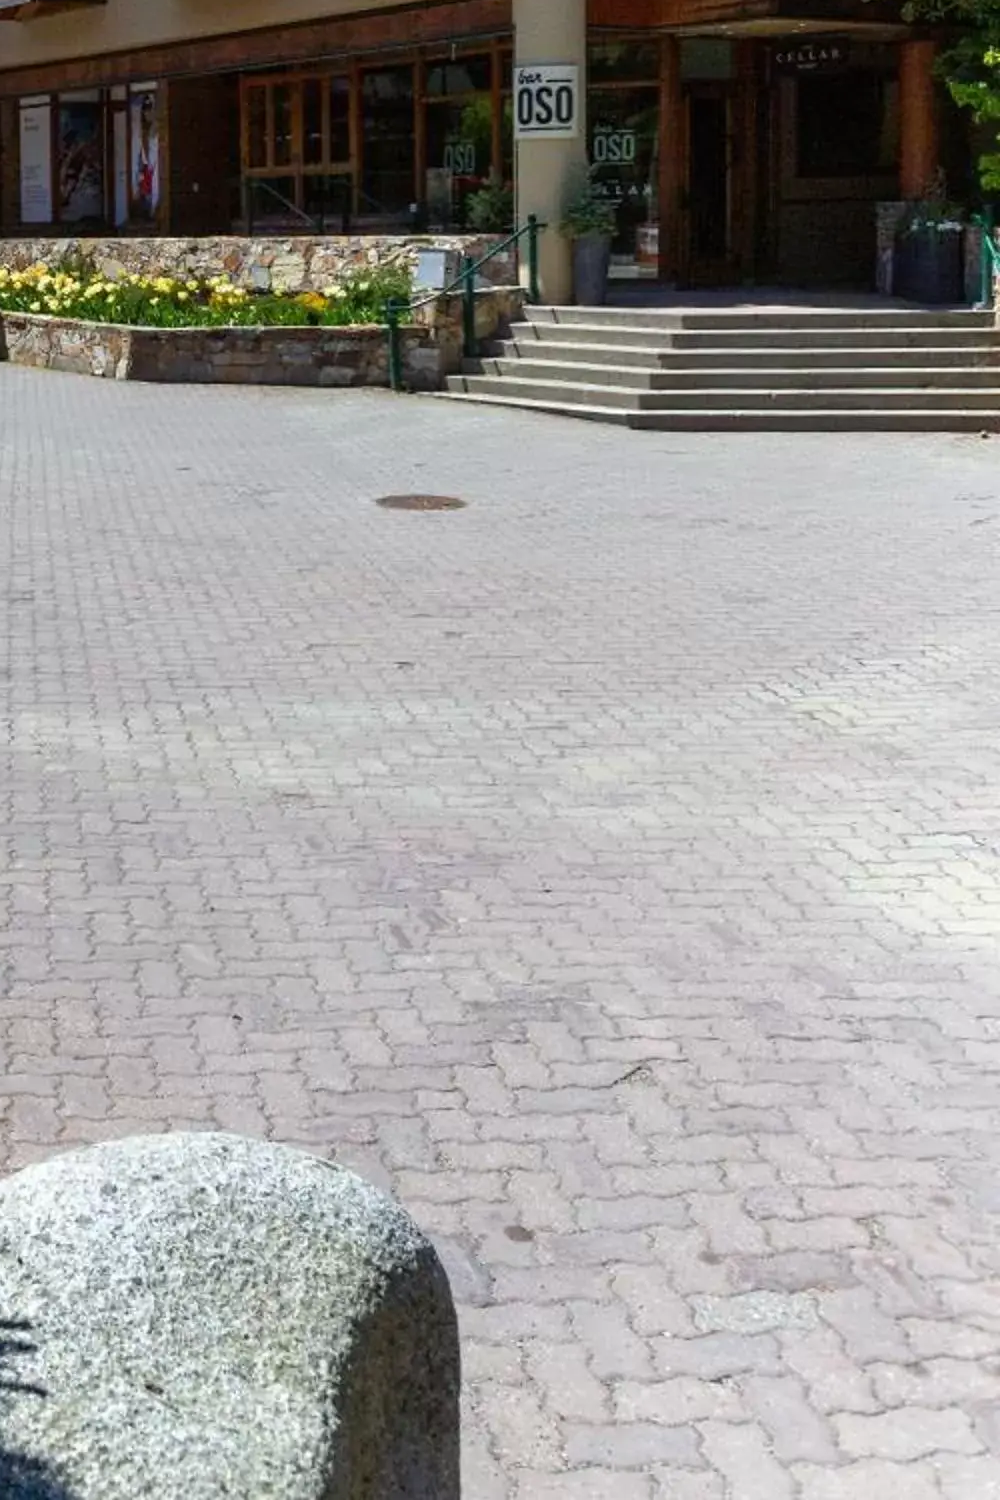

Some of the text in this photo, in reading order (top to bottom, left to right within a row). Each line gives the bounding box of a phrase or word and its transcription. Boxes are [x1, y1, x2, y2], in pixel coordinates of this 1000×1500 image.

[518, 69, 542, 84] bar
[518, 86, 573, 125] OSO
[594, 134, 635, 161] OSO
